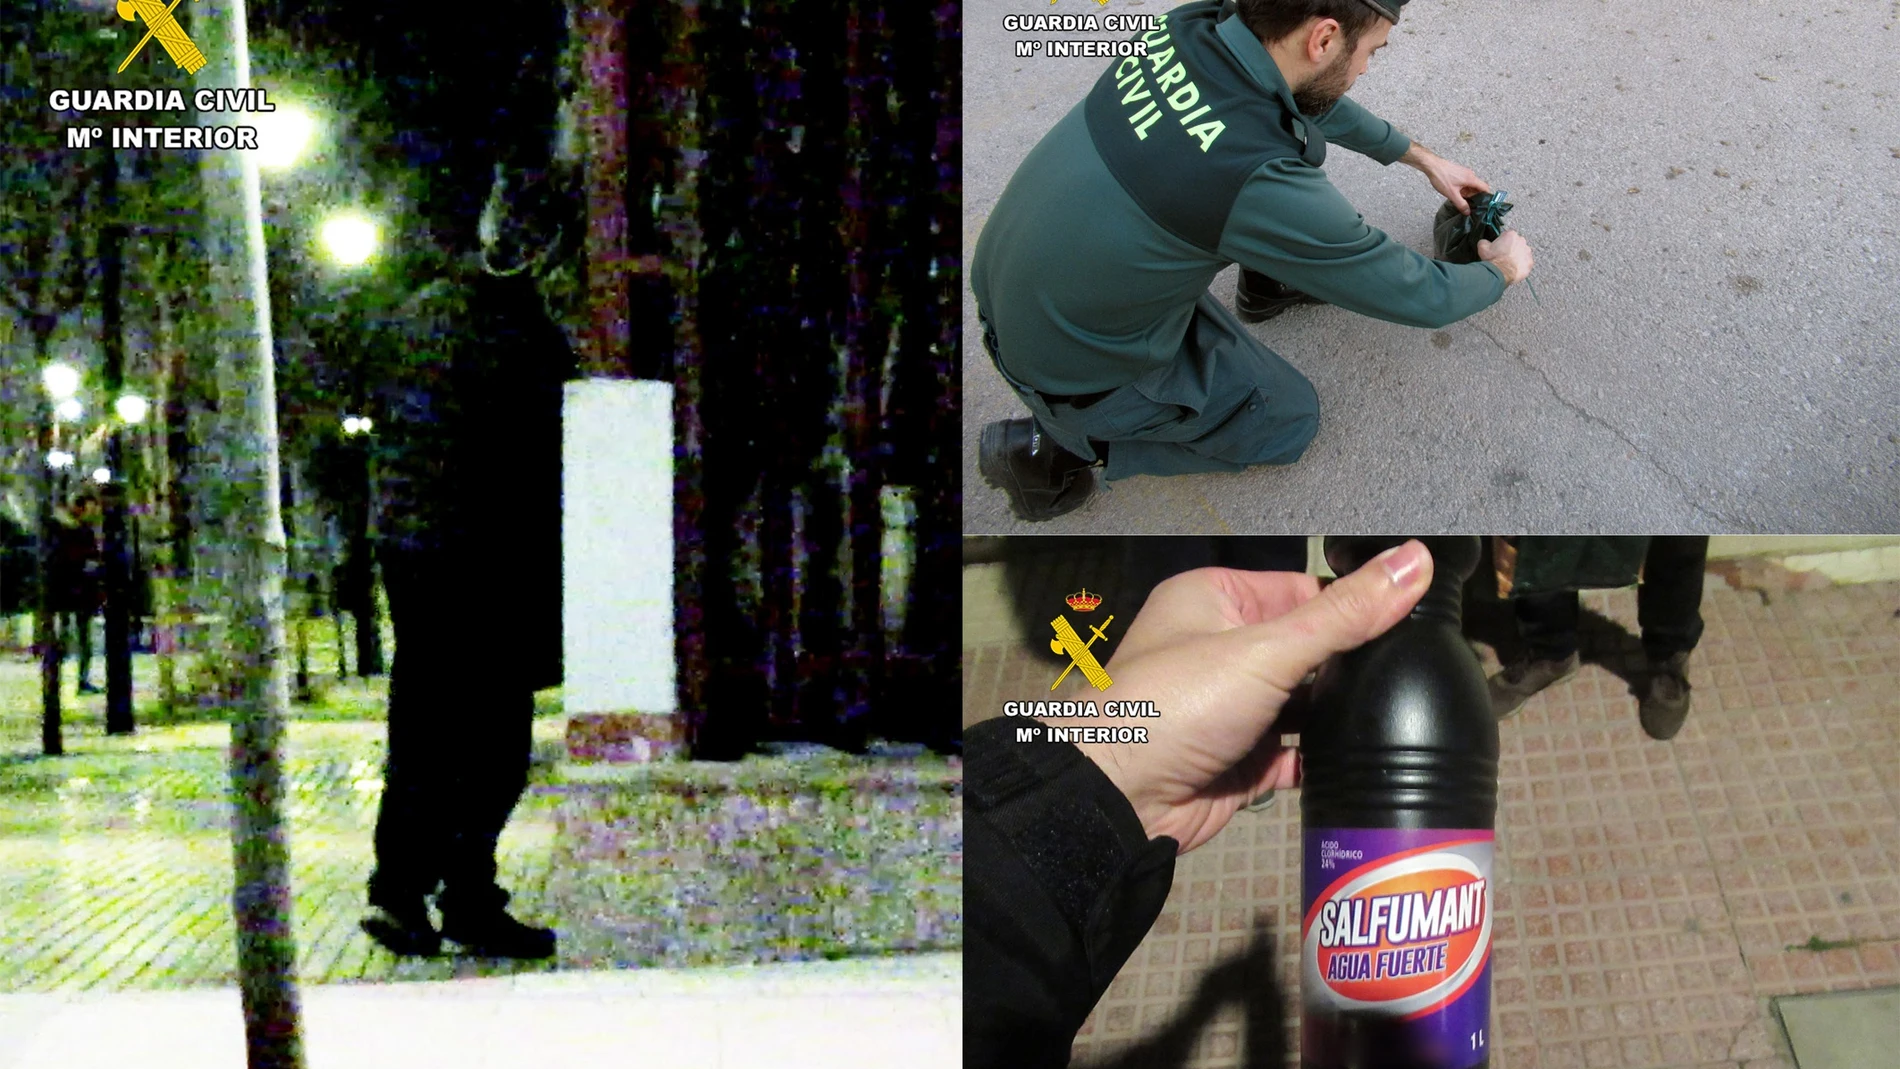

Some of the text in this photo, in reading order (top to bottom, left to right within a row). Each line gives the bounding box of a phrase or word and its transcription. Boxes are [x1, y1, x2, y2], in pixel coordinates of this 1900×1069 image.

[1115, 56, 1163, 141] CIVIL
[1320, 879, 1485, 947] SALFUMANT
[1327, 943, 1448, 980] AGUA FUERTE
[1471, 1029, 1485, 1050] 1 L
